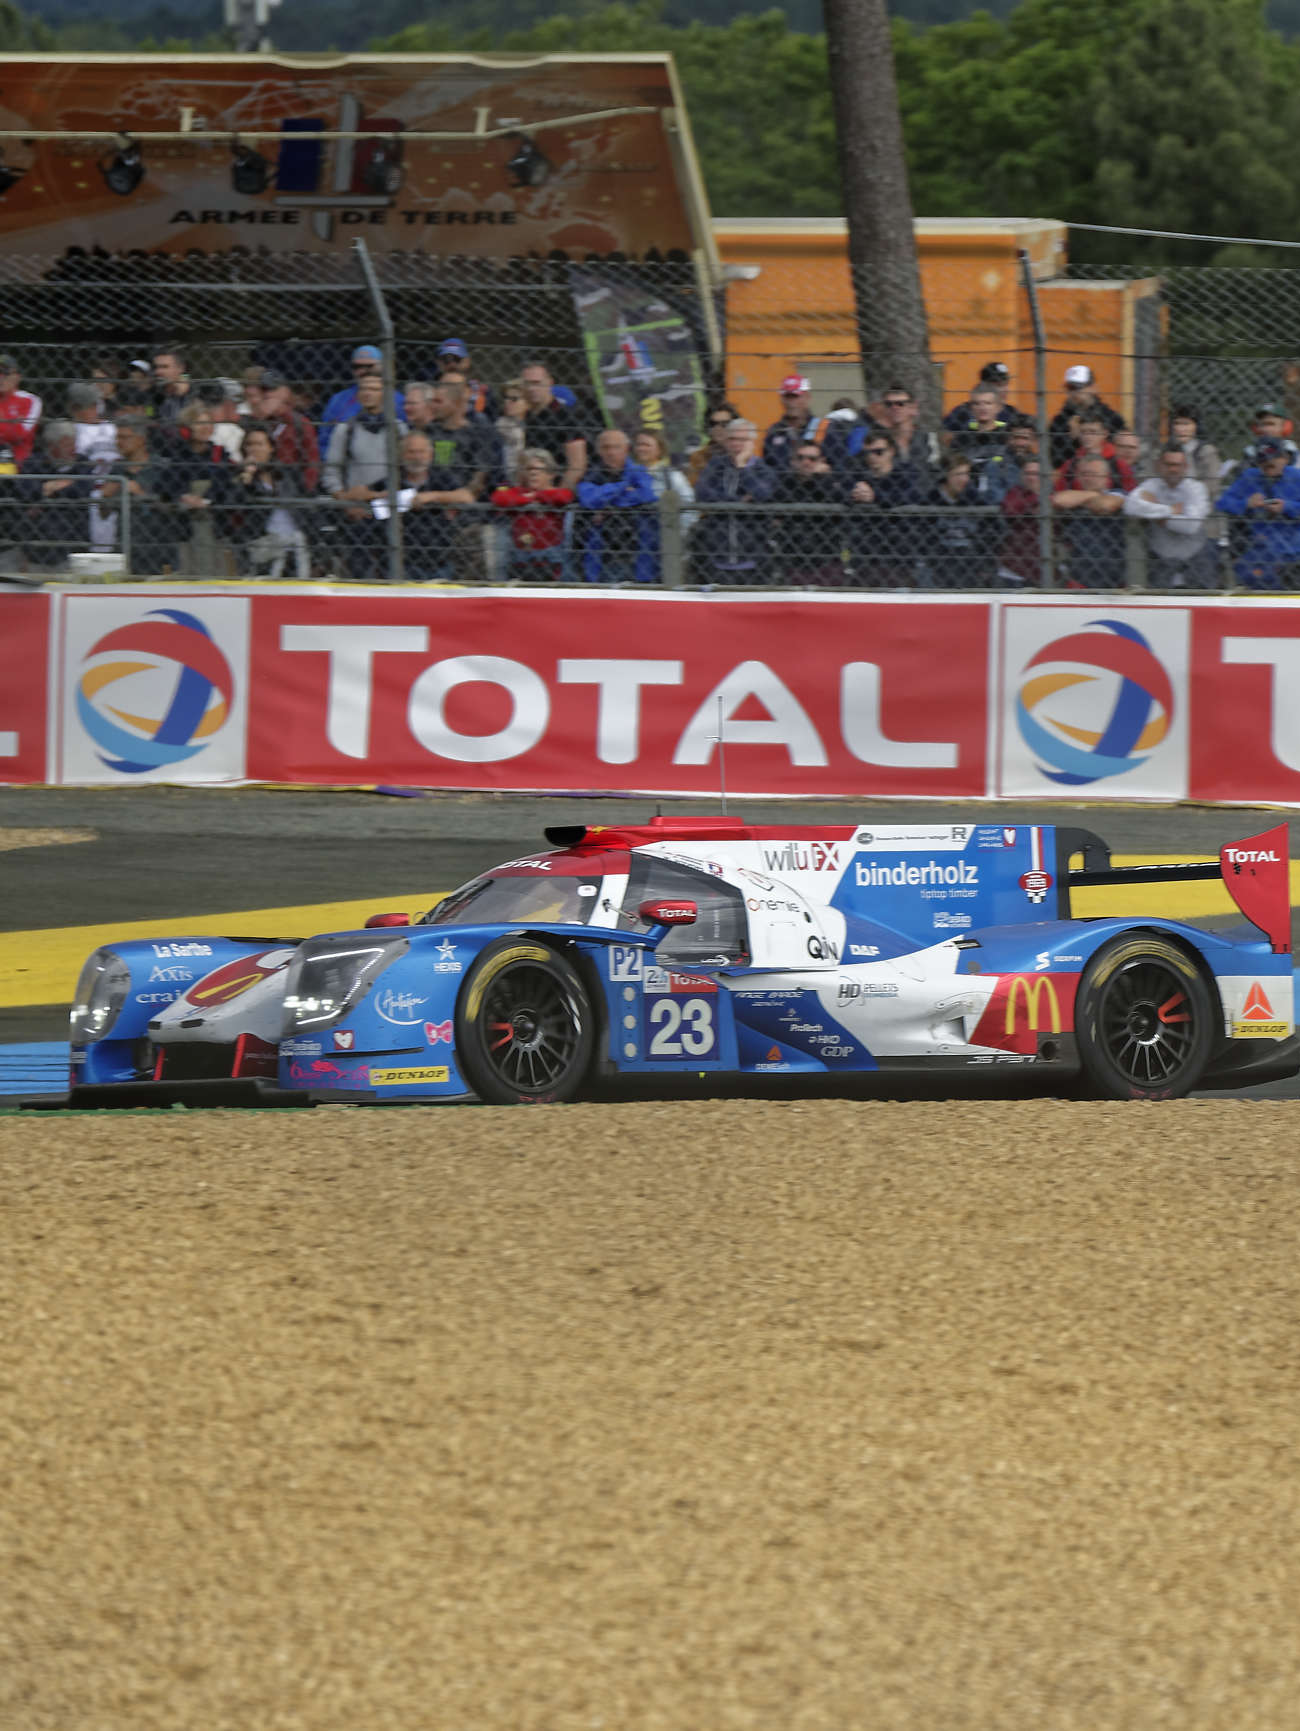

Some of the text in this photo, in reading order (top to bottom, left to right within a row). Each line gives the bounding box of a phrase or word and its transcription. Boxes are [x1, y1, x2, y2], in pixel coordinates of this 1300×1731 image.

[169, 210, 518, 226] ARMEE DE TERRE
[280, 624, 960, 768] TOTAL
[1224, 848, 1280, 863] TOTAL
[496, 860, 553, 871] OTAL
[855, 860, 979, 886] binderholz
[656, 908, 697, 918] TOTAL
[152, 943, 213, 958] La Sarthe
[613, 947, 639, 976] P2
[838, 984, 861, 999] HD
[650, 998, 716, 1056] 23
[1240, 1025, 1286, 1033] DUNLOP
[385, 1069, 446, 1081] DUNLOP
